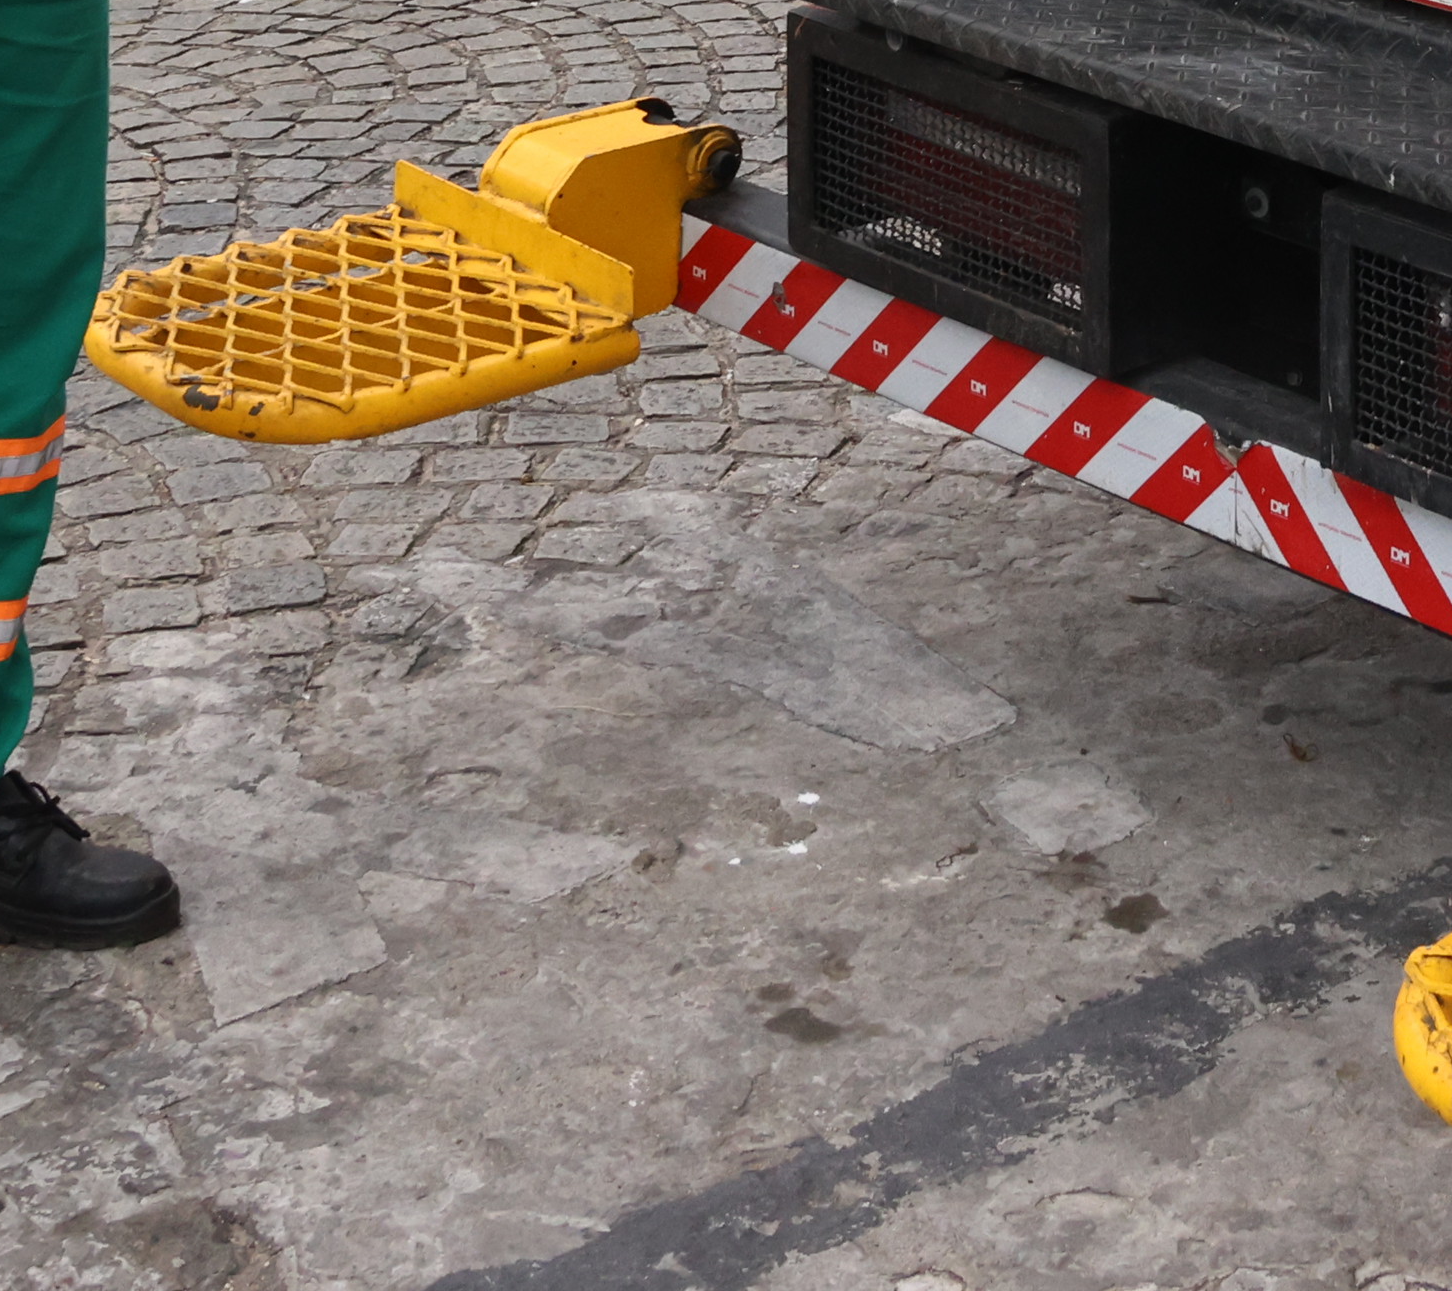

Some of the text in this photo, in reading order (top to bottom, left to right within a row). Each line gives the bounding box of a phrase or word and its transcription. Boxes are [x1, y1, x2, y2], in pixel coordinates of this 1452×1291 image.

[873, 340, 889, 355] DM
[971, 380, 987, 396] DM
[1073, 421, 1091, 437] DM
[1183, 465, 1201, 481] DM
[1270, 499, 1289, 516] DM
[1391, 546, 1410, 565] DM
